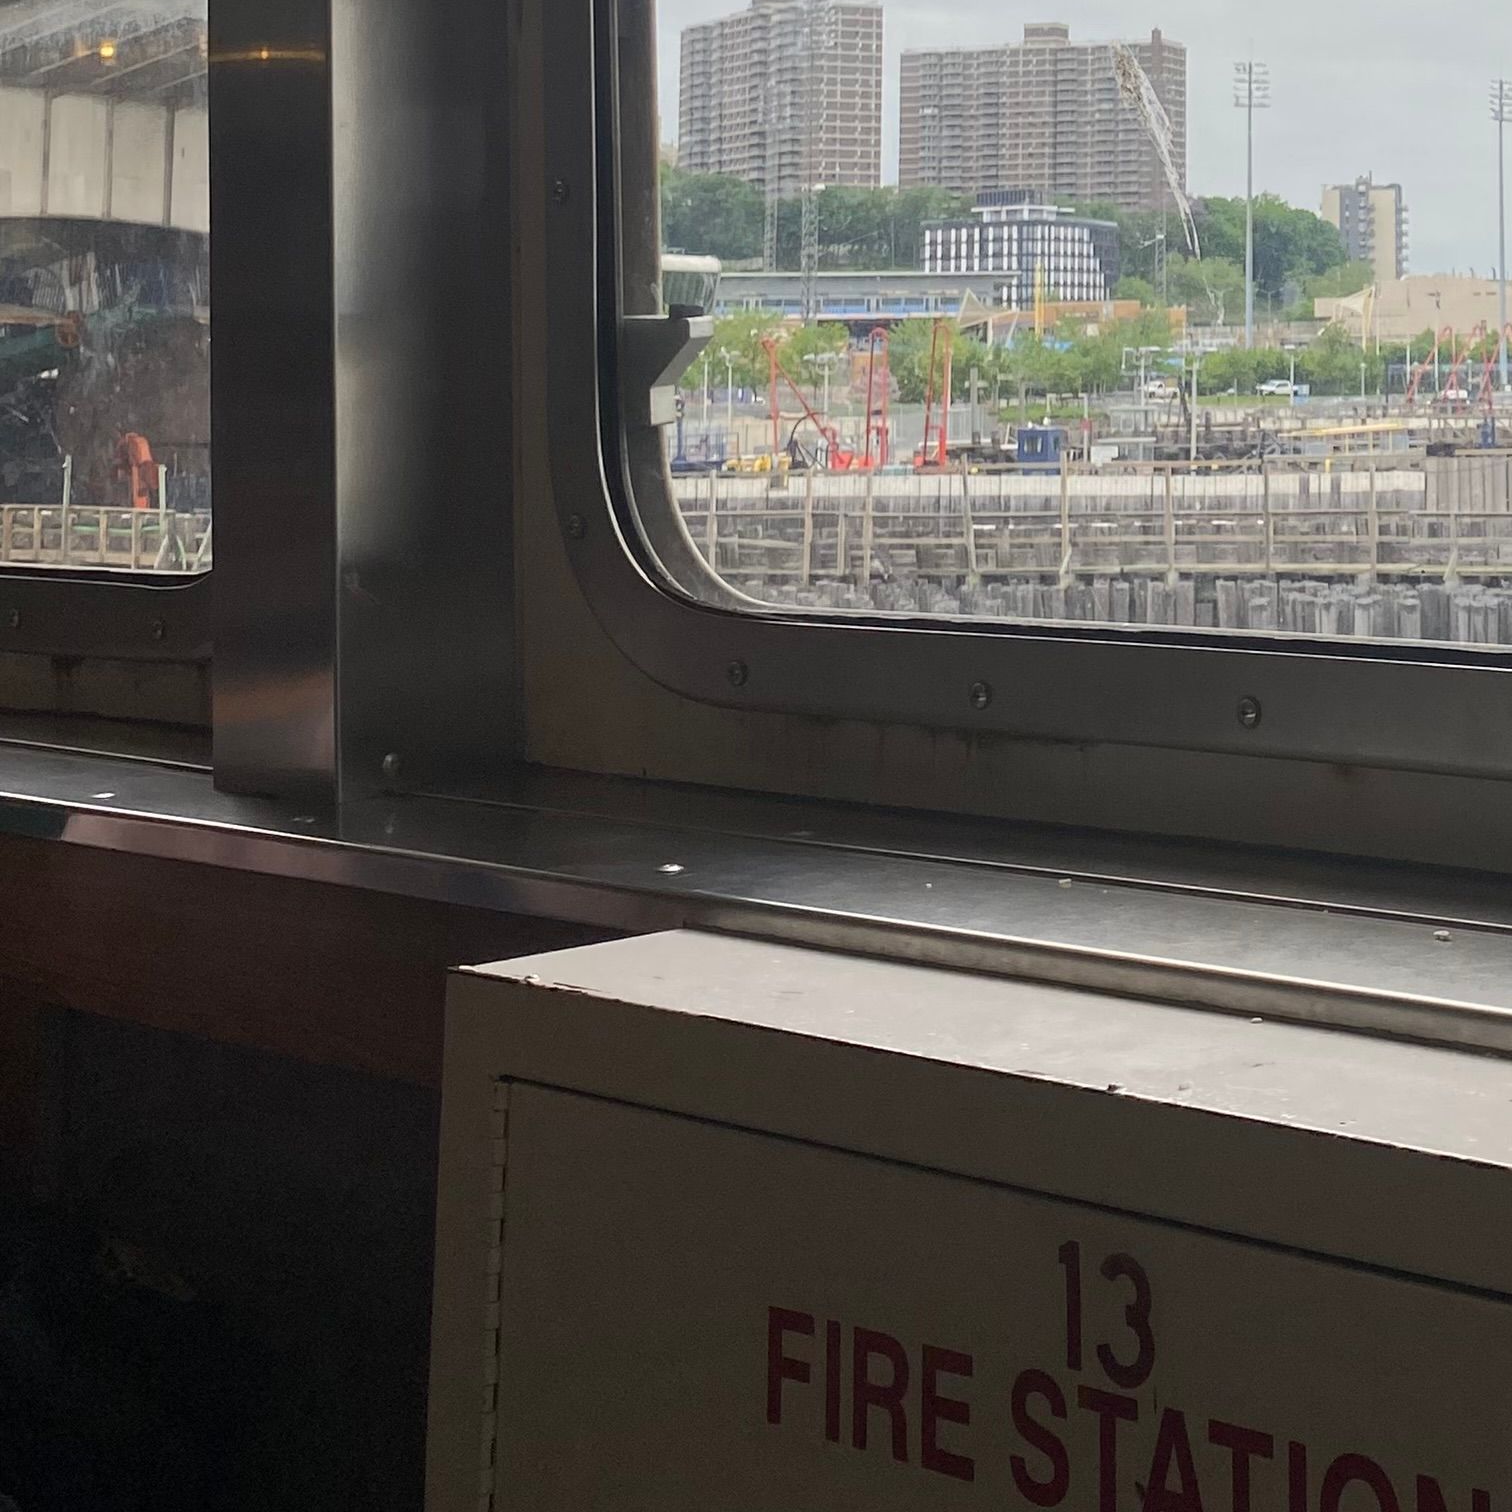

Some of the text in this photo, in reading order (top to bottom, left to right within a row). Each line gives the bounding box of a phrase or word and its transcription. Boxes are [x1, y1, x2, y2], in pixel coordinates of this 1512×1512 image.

[1059, 1240, 1156, 1389] 13
[766, 1305, 1490, 1512] FIRE STATI
